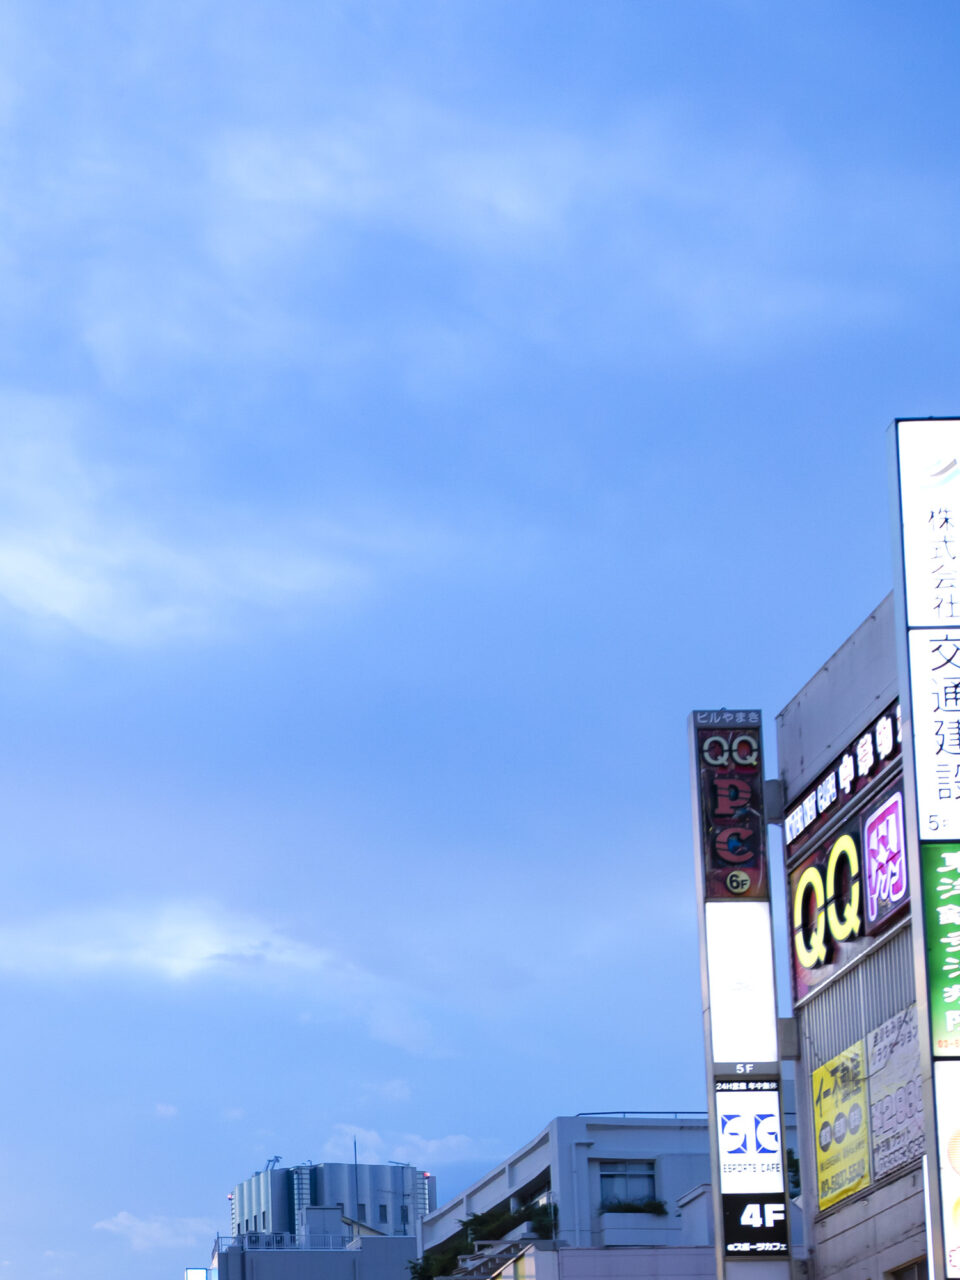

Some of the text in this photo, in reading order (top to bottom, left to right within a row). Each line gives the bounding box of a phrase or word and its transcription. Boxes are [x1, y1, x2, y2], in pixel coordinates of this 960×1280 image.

[702, 735, 758, 766] QQ
[727, 874, 748, 891] 6F
[793, 834, 861, 968] QQ
[736, 1063, 754, 1074] 5F
[740, 1203, 785, 1228] 4F
